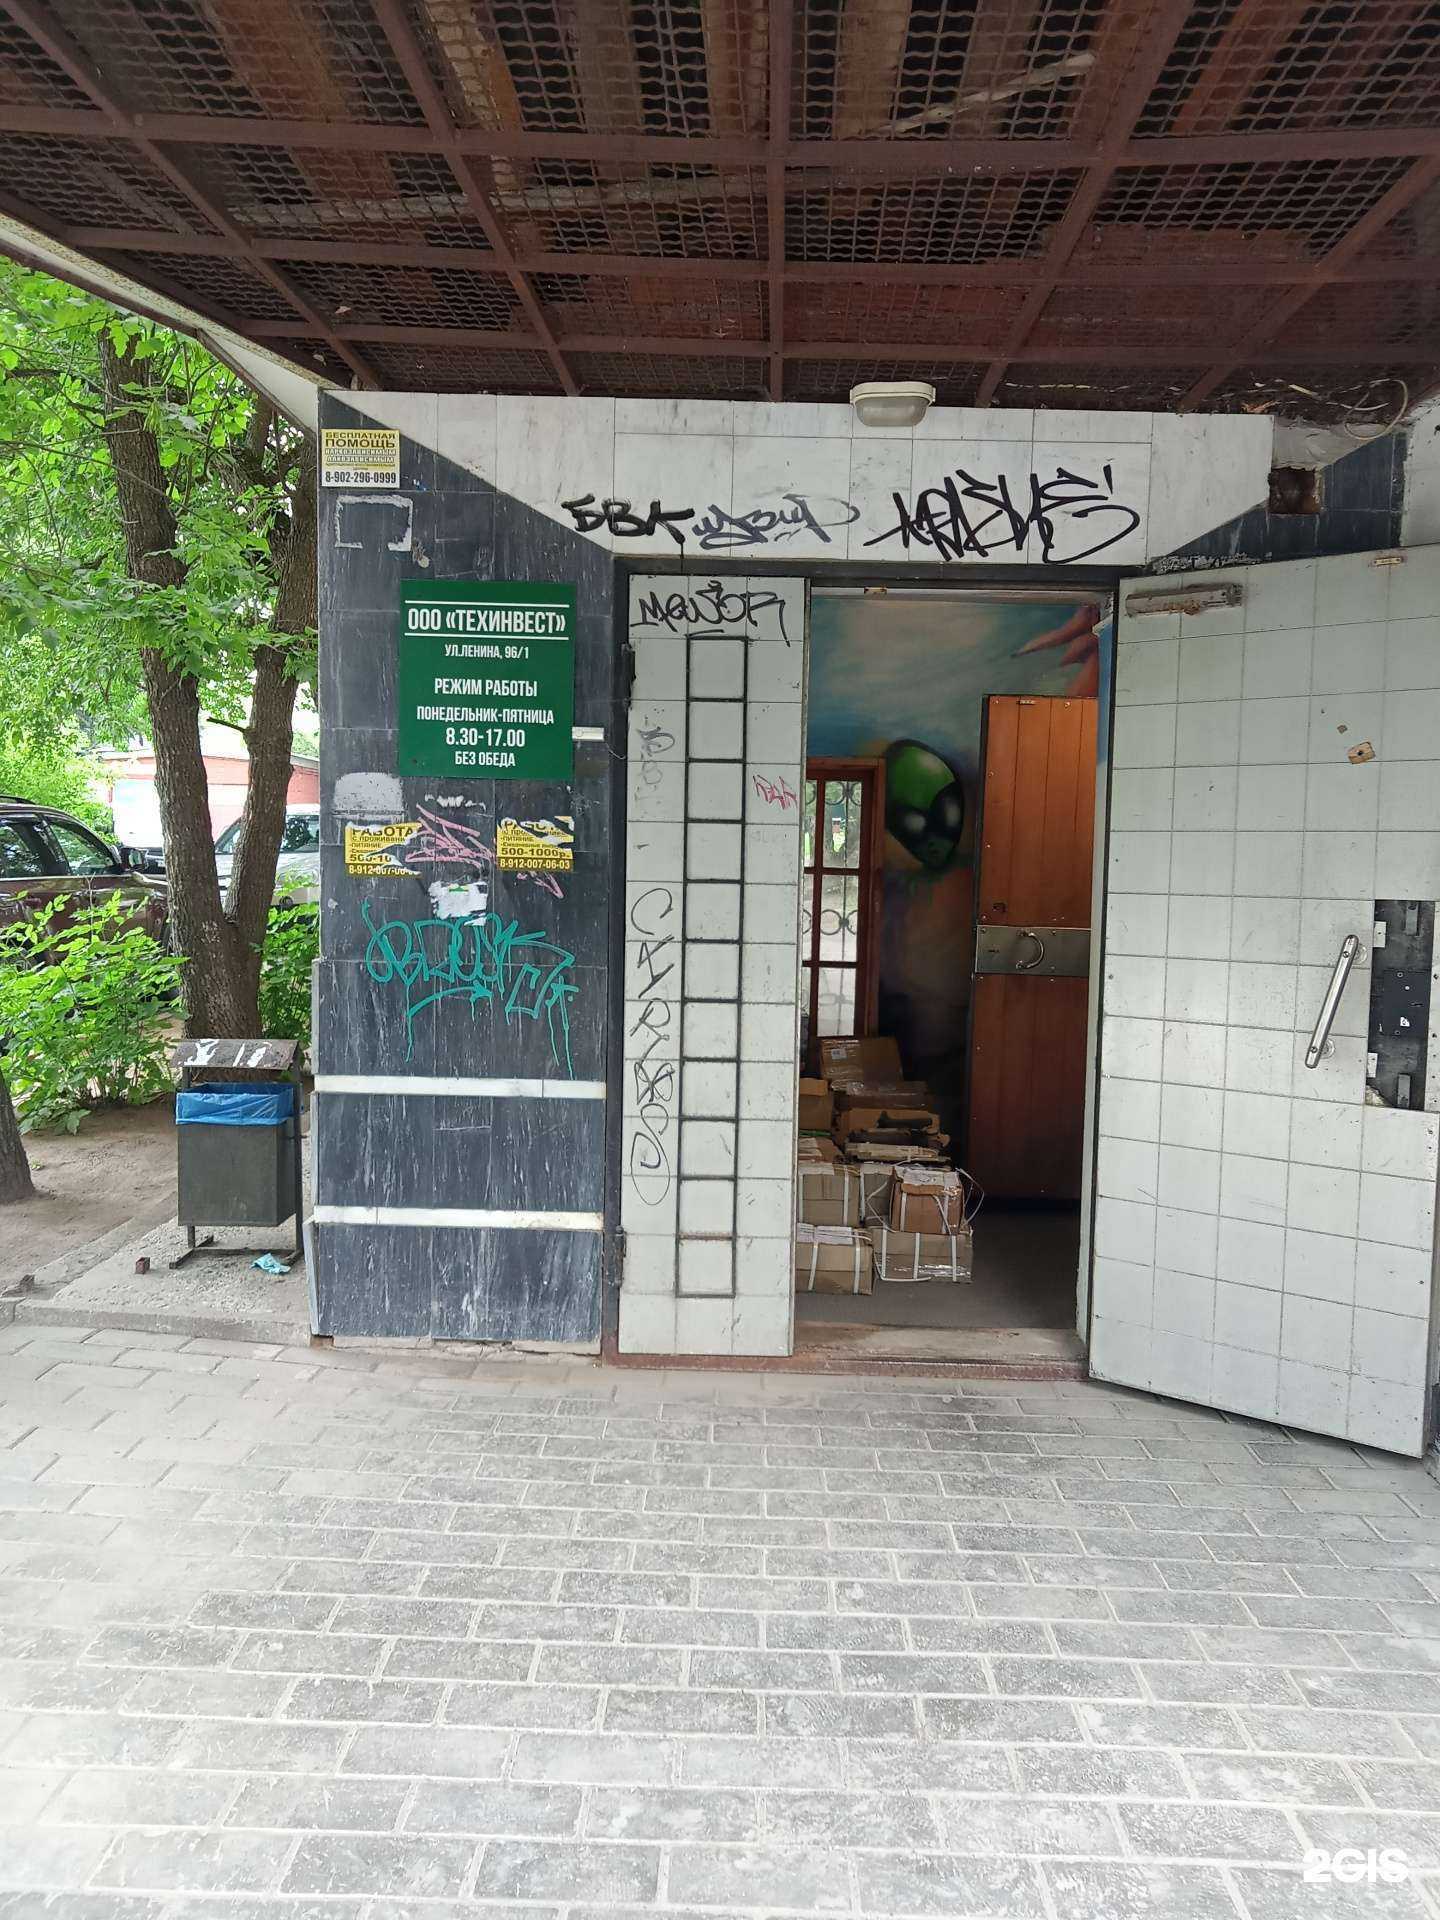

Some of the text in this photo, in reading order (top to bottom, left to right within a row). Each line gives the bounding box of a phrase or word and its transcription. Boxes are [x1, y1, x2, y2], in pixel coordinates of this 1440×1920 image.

[325, 431, 396, 440] БЕСПЛАТНАЯ
[325, 438, 396, 450] ПОМОЩЬ
[325, 471, 397, 484] 8-902-296-0999
[407, 607, 567, 634] ООО «ТЕХИНВЕСТ»
[444, 643, 529, 660] УЛ.ЛЕНИНА, 96/1
[434, 677, 538, 697] РЕЖИМ РАБОТЫ
[416, 705, 555, 726] ПОНЕДЕЛЬНИК-ПЯТНИЦА
[445, 727, 526, 748] 8.30-17.00
[454, 751, 516, 768] БЕЗ ОБЕДА
[500, 858, 570, 870] 8-912-007-06-03
